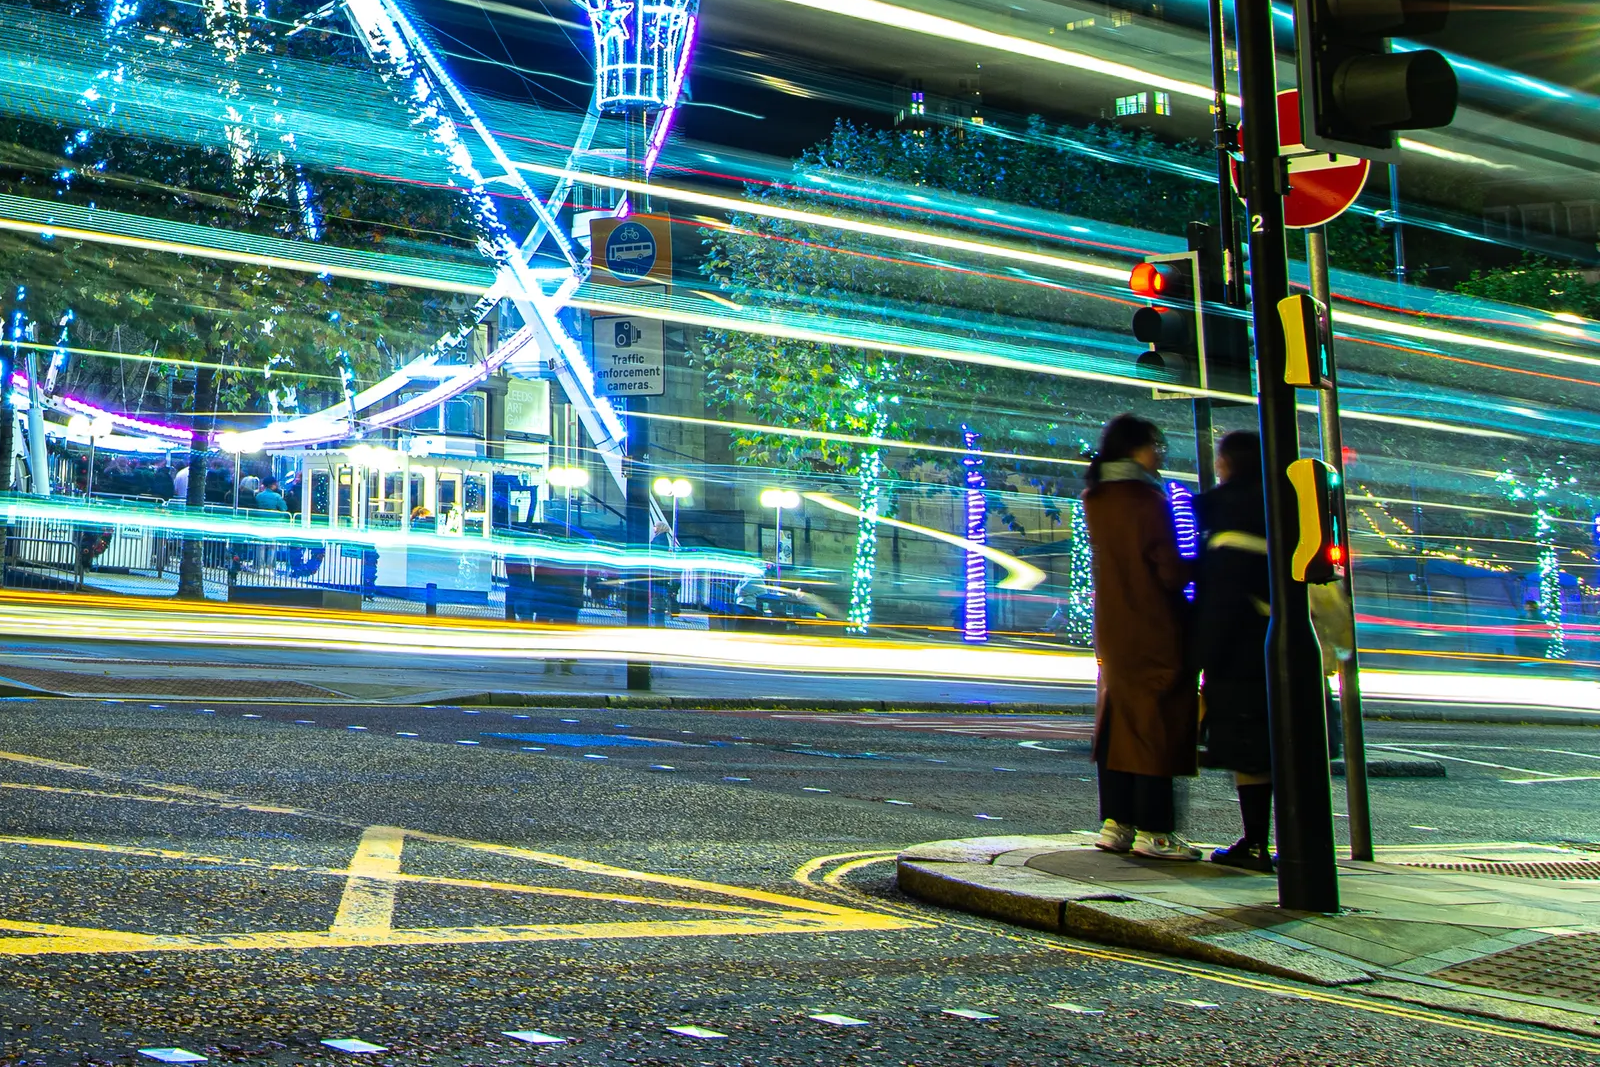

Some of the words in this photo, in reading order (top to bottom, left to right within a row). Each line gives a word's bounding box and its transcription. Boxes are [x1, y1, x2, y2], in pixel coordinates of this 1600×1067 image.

[1251, 214, 1265, 232] 2
[623, 266, 639, 274] taxi
[612, 353, 645, 365] Traffic
[597, 366, 660, 379] enforcement
[508, 389, 533, 403] LEEDS
[507, 403, 523, 414] ART
